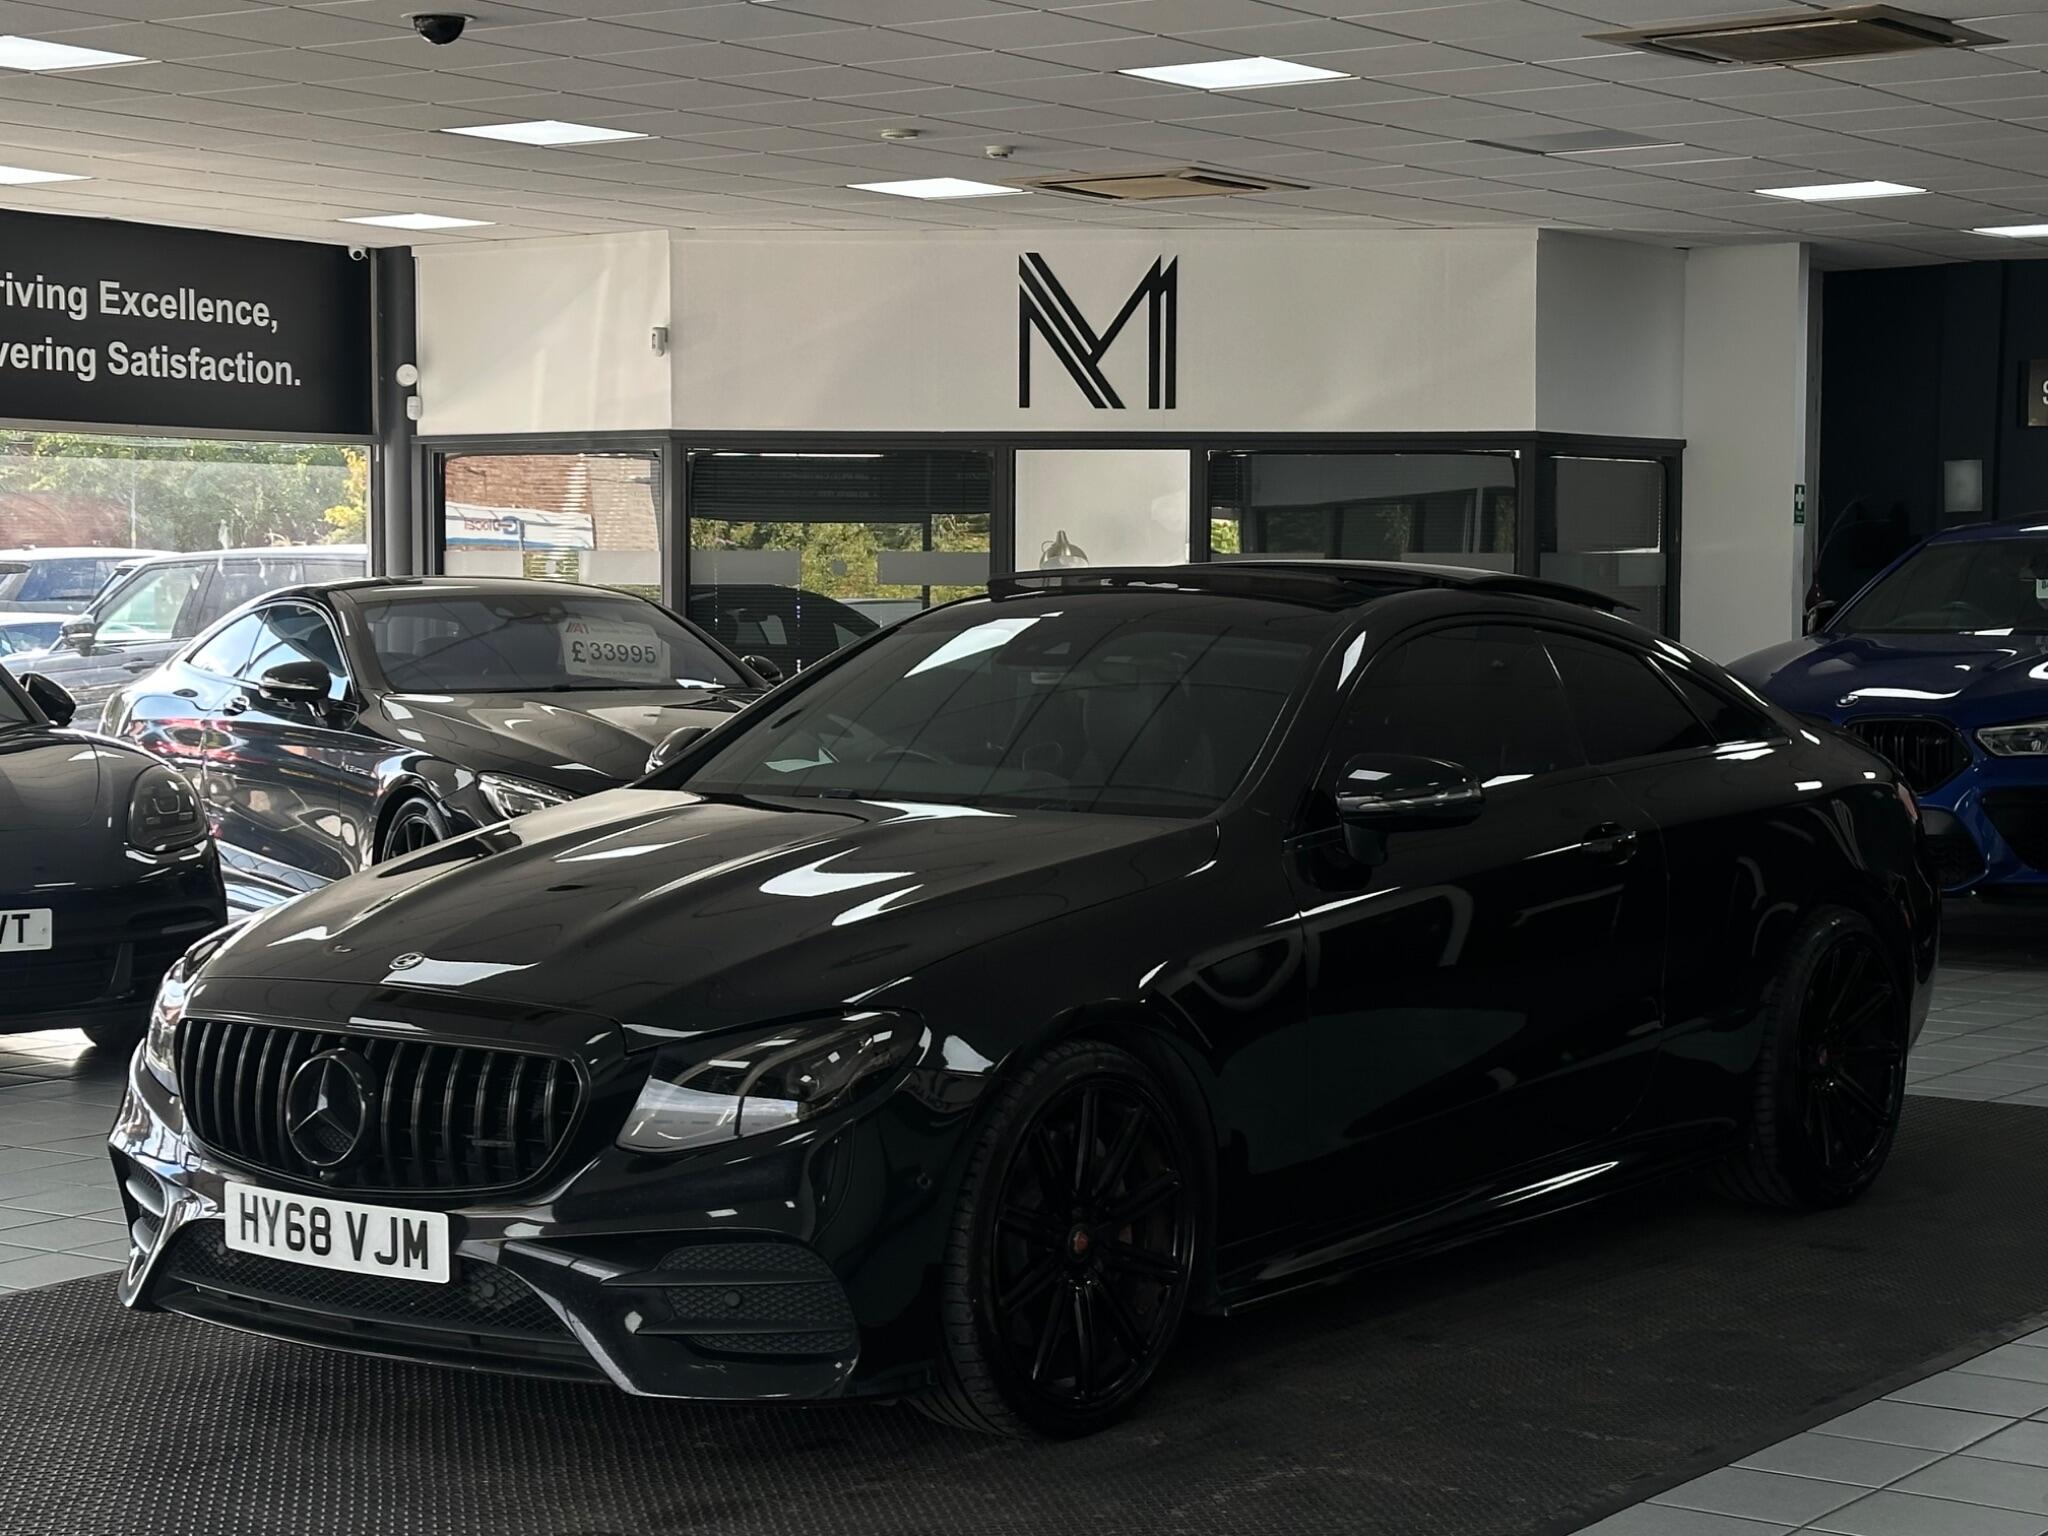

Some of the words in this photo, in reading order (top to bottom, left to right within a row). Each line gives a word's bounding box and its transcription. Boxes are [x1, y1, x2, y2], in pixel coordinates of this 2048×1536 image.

[100, 281, 278, 333] Excellence,
[108, 341, 301, 386] Satisfaction.
[571, 641, 657, 664] £33995
[240, 1192, 332, 1256] HY68
[345, 1211, 429, 1270] VJM
